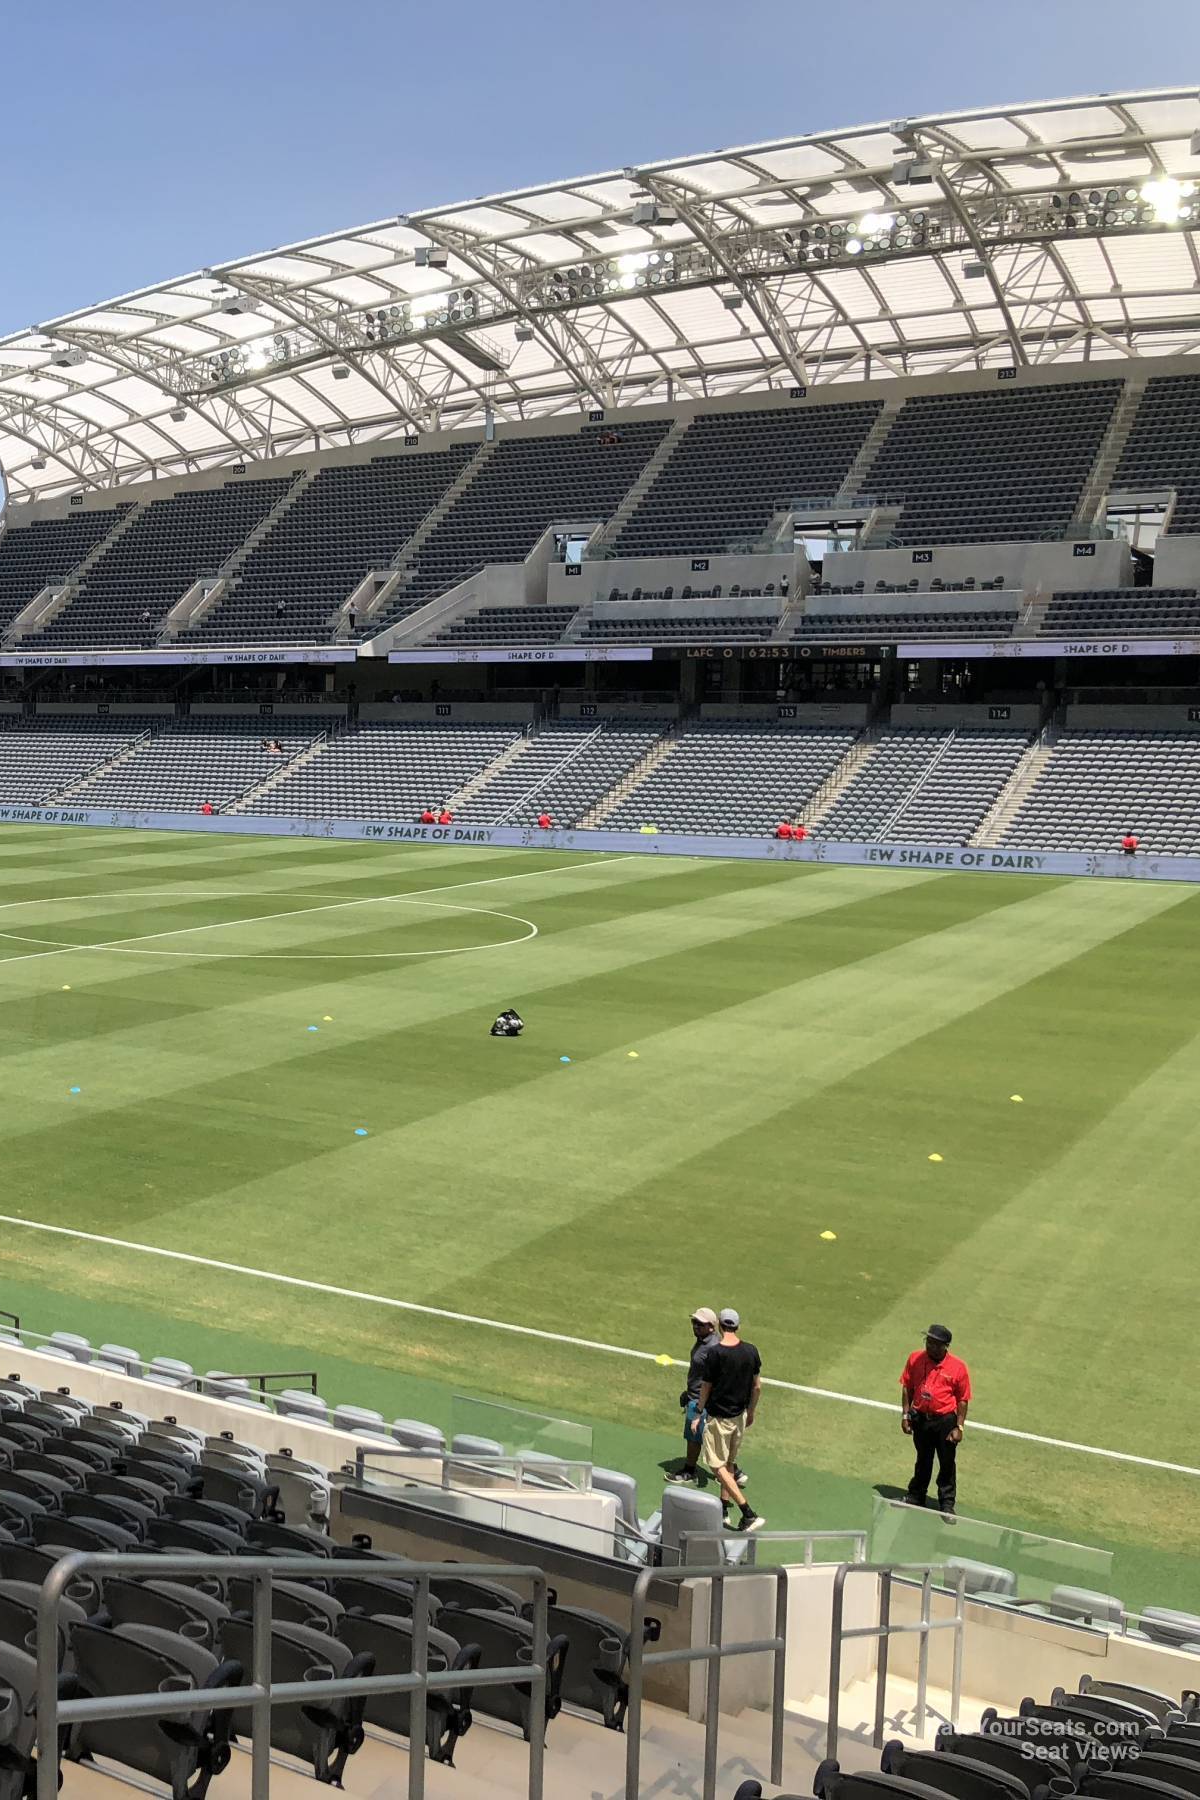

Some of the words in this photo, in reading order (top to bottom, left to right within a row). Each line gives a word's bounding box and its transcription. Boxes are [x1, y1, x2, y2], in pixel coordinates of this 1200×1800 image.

[1076, 547, 1092, 555] M4
[915, 553, 930, 561] M3
[694, 562, 706, 570] M2
[568, 567, 578, 575] M1
[687, 648, 714, 658] LAFC
[748, 647, 789, 658] 62:53
[822, 647, 866, 657] TIMBERS
[1102, 644, 1118, 653] OF
[234, 654, 256, 662] SHAPE
[535, 652, 546, 660] OF
[780, 708, 795, 717] 113
[991, 709, 1008, 719] 114
[12, 809, 42, 820] SHAPE
[44, 811, 59, 821] OF
[60, 812, 91, 823] DAIRY
[361, 825, 385, 837] EW
[387, 826, 428, 839] SHAPE
[431, 828, 450, 841] OF
[454, 829, 495, 842] DAIRY
[864, 848, 894, 861] EW
[899, 850, 954, 865] SHAPE
[960, 853, 985, 867] OF
[991, 854, 1047, 869] DAIRY
